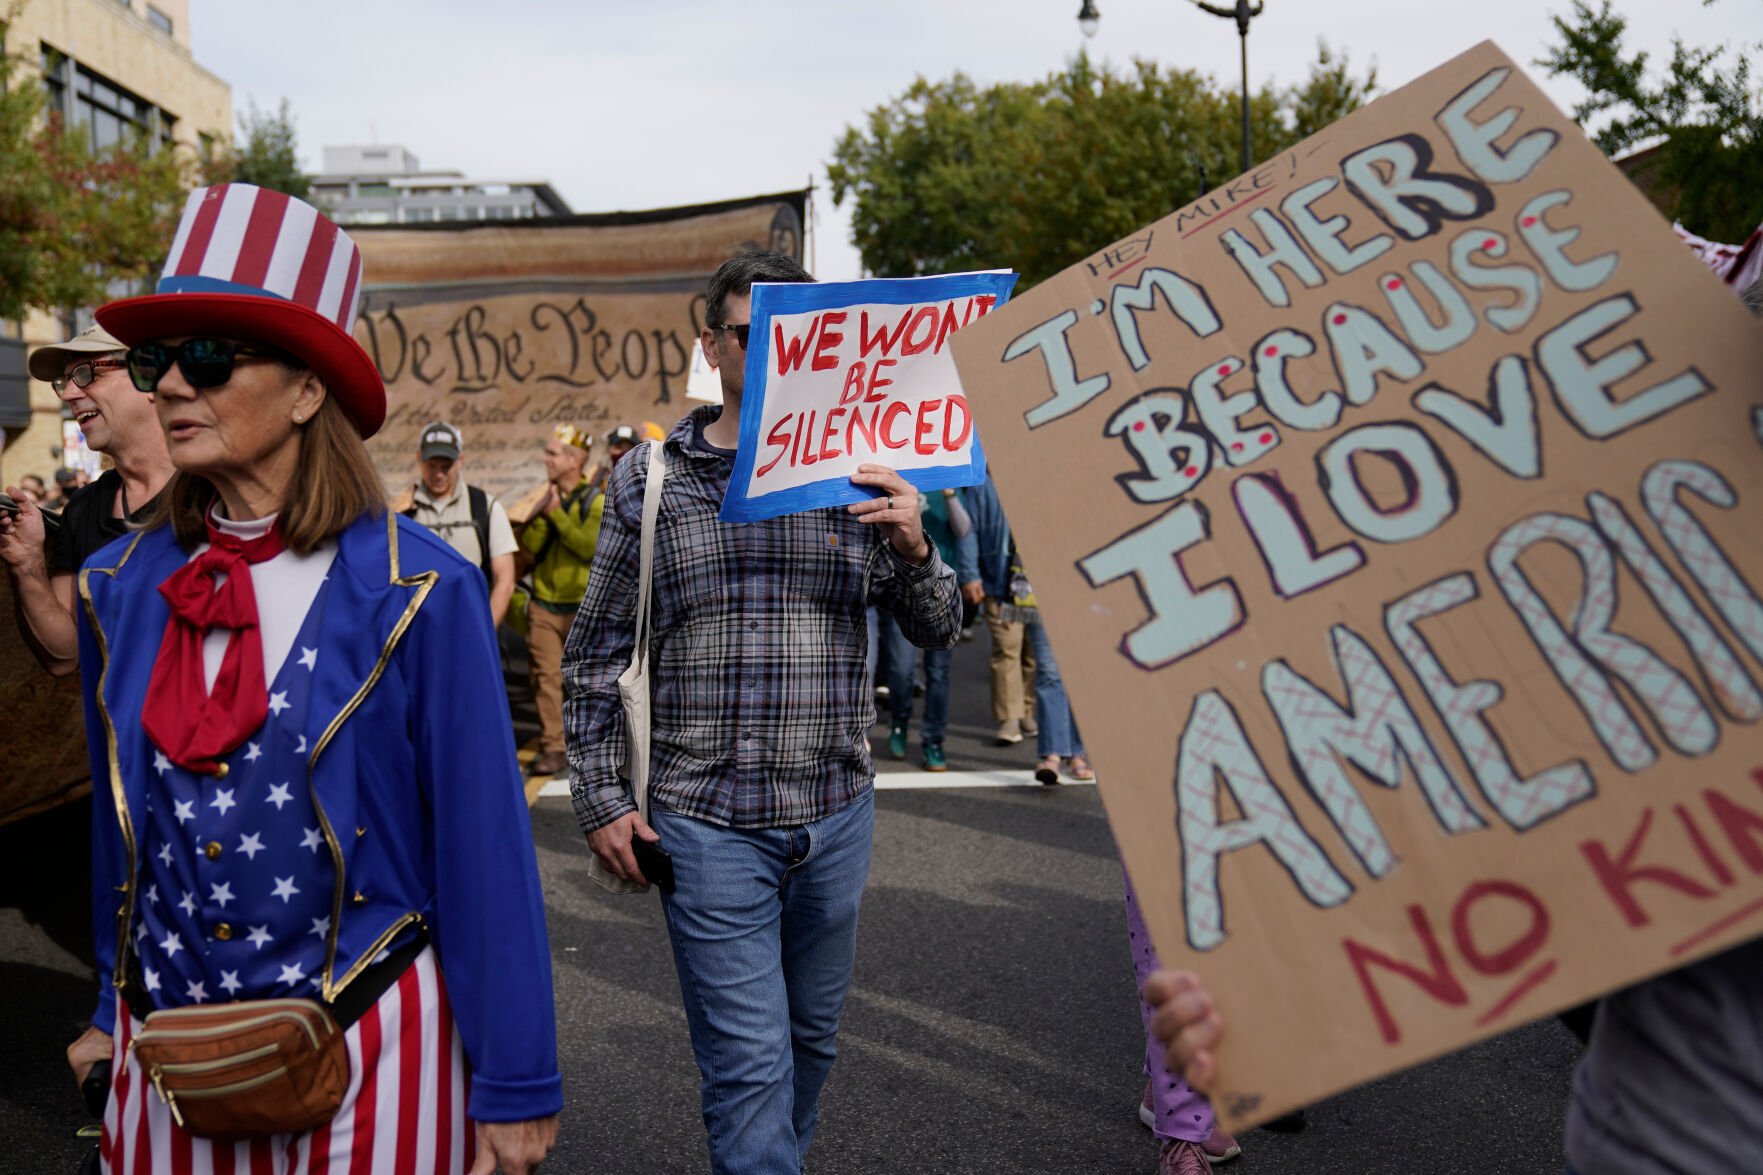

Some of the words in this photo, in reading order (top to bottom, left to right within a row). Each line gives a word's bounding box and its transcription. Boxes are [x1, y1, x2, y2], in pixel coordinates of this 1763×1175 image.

[1001, 266, 1225, 430] I'M
[1218, 66, 1562, 308] HERE
[1087, 230, 1154, 277] HEY
[1175, 152, 1297, 233] MIKE!
[446, 304, 535, 393] the
[773, 310, 848, 377] WE
[839, 358, 898, 406] BE
[1101, 189, 1620, 505] BECAUSE
[756, 393, 975, 479] SILENCED
[1075, 498, 1249, 672] I
[1231, 290, 1718, 600] LOVE
[1174, 404, 1763, 952] AMERIC
[1342, 878, 1552, 1047] NO
